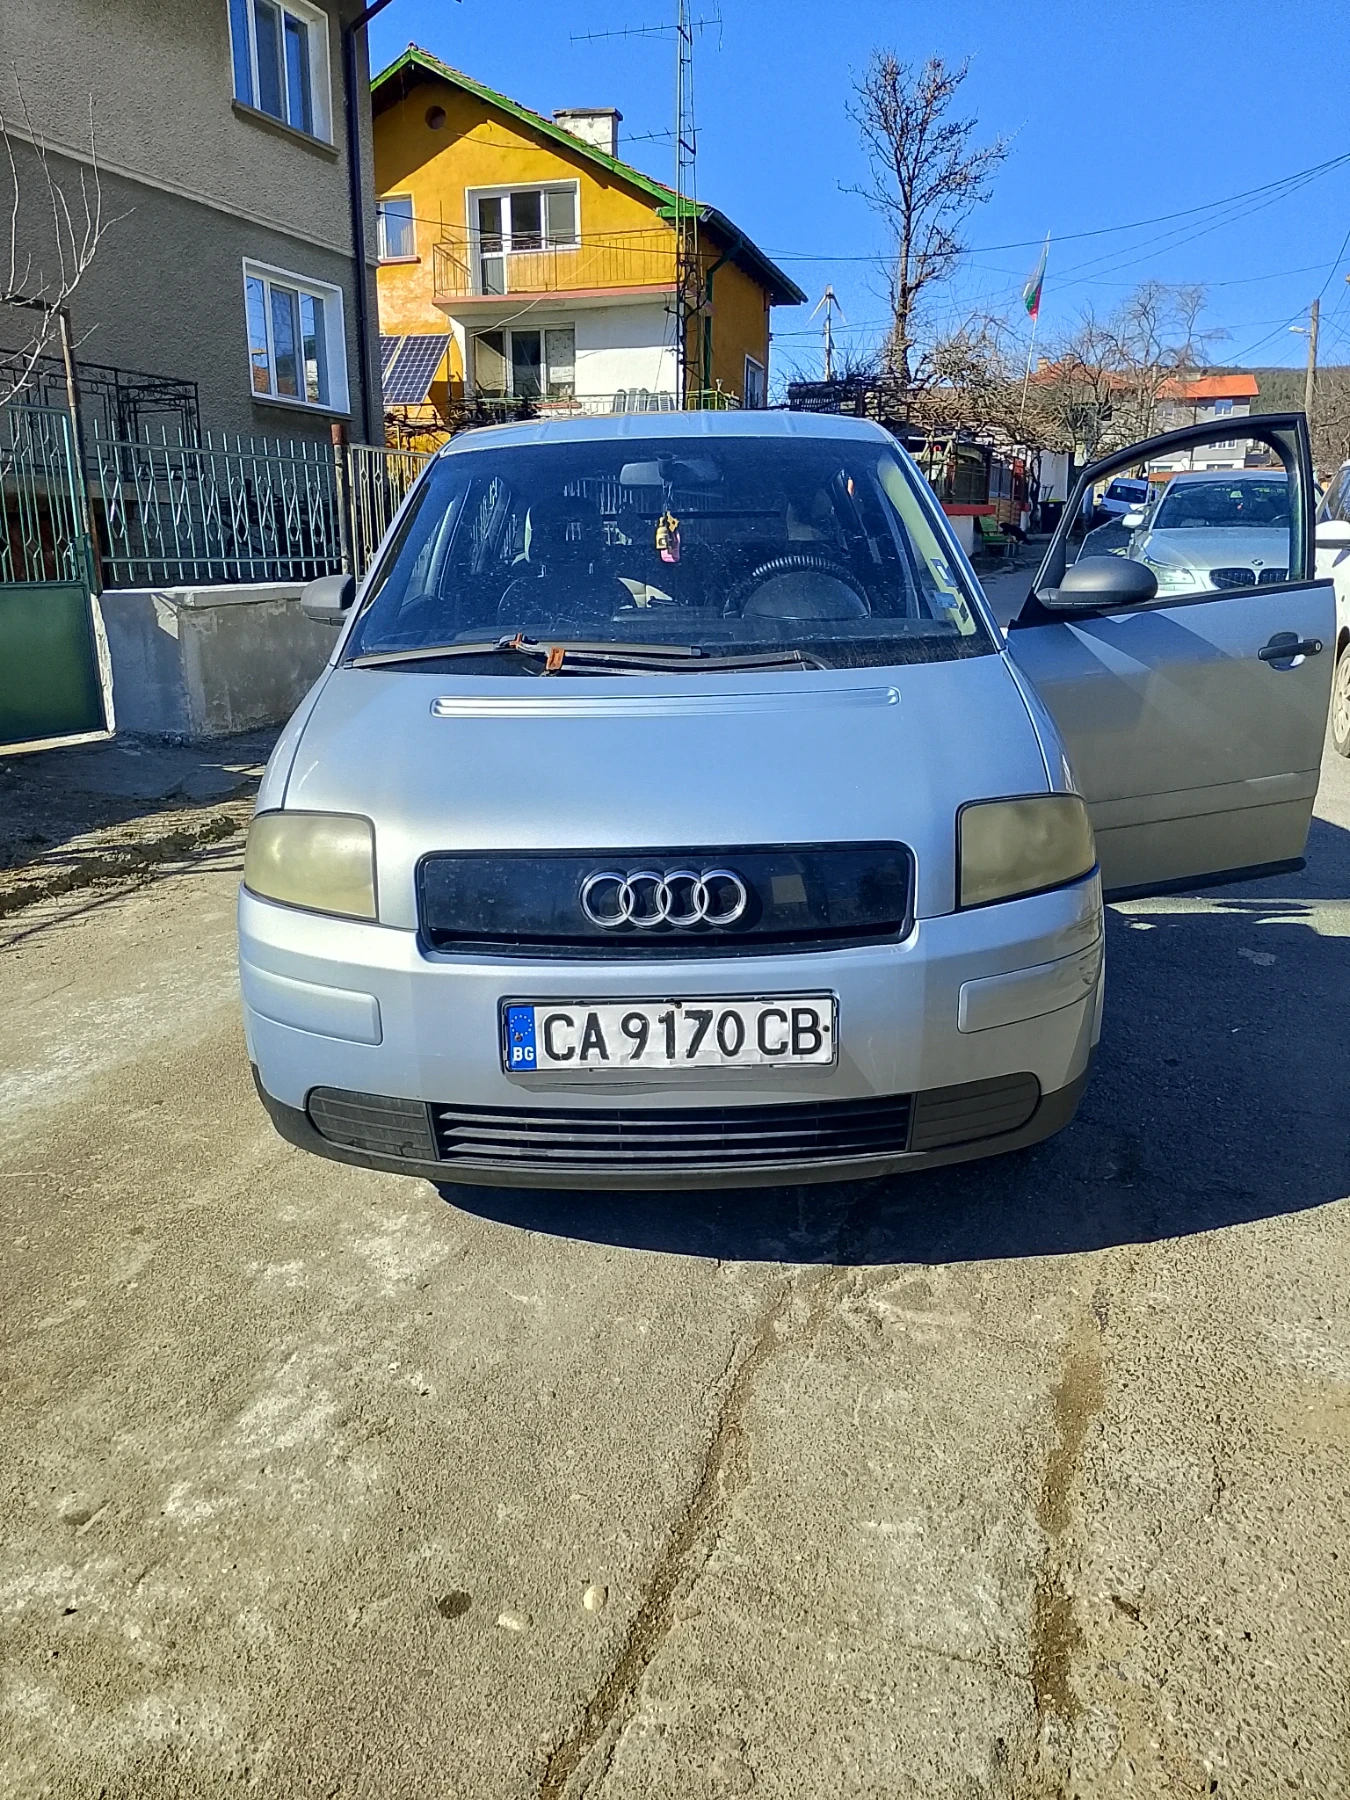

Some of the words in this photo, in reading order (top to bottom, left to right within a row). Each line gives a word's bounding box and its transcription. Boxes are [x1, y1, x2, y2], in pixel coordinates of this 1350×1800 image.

[543, 1012, 610, 1061] CA
[621, 1008, 746, 1060] 9170
[757, 1007, 822, 1057] CB
[513, 1046, 534, 1061] BG
